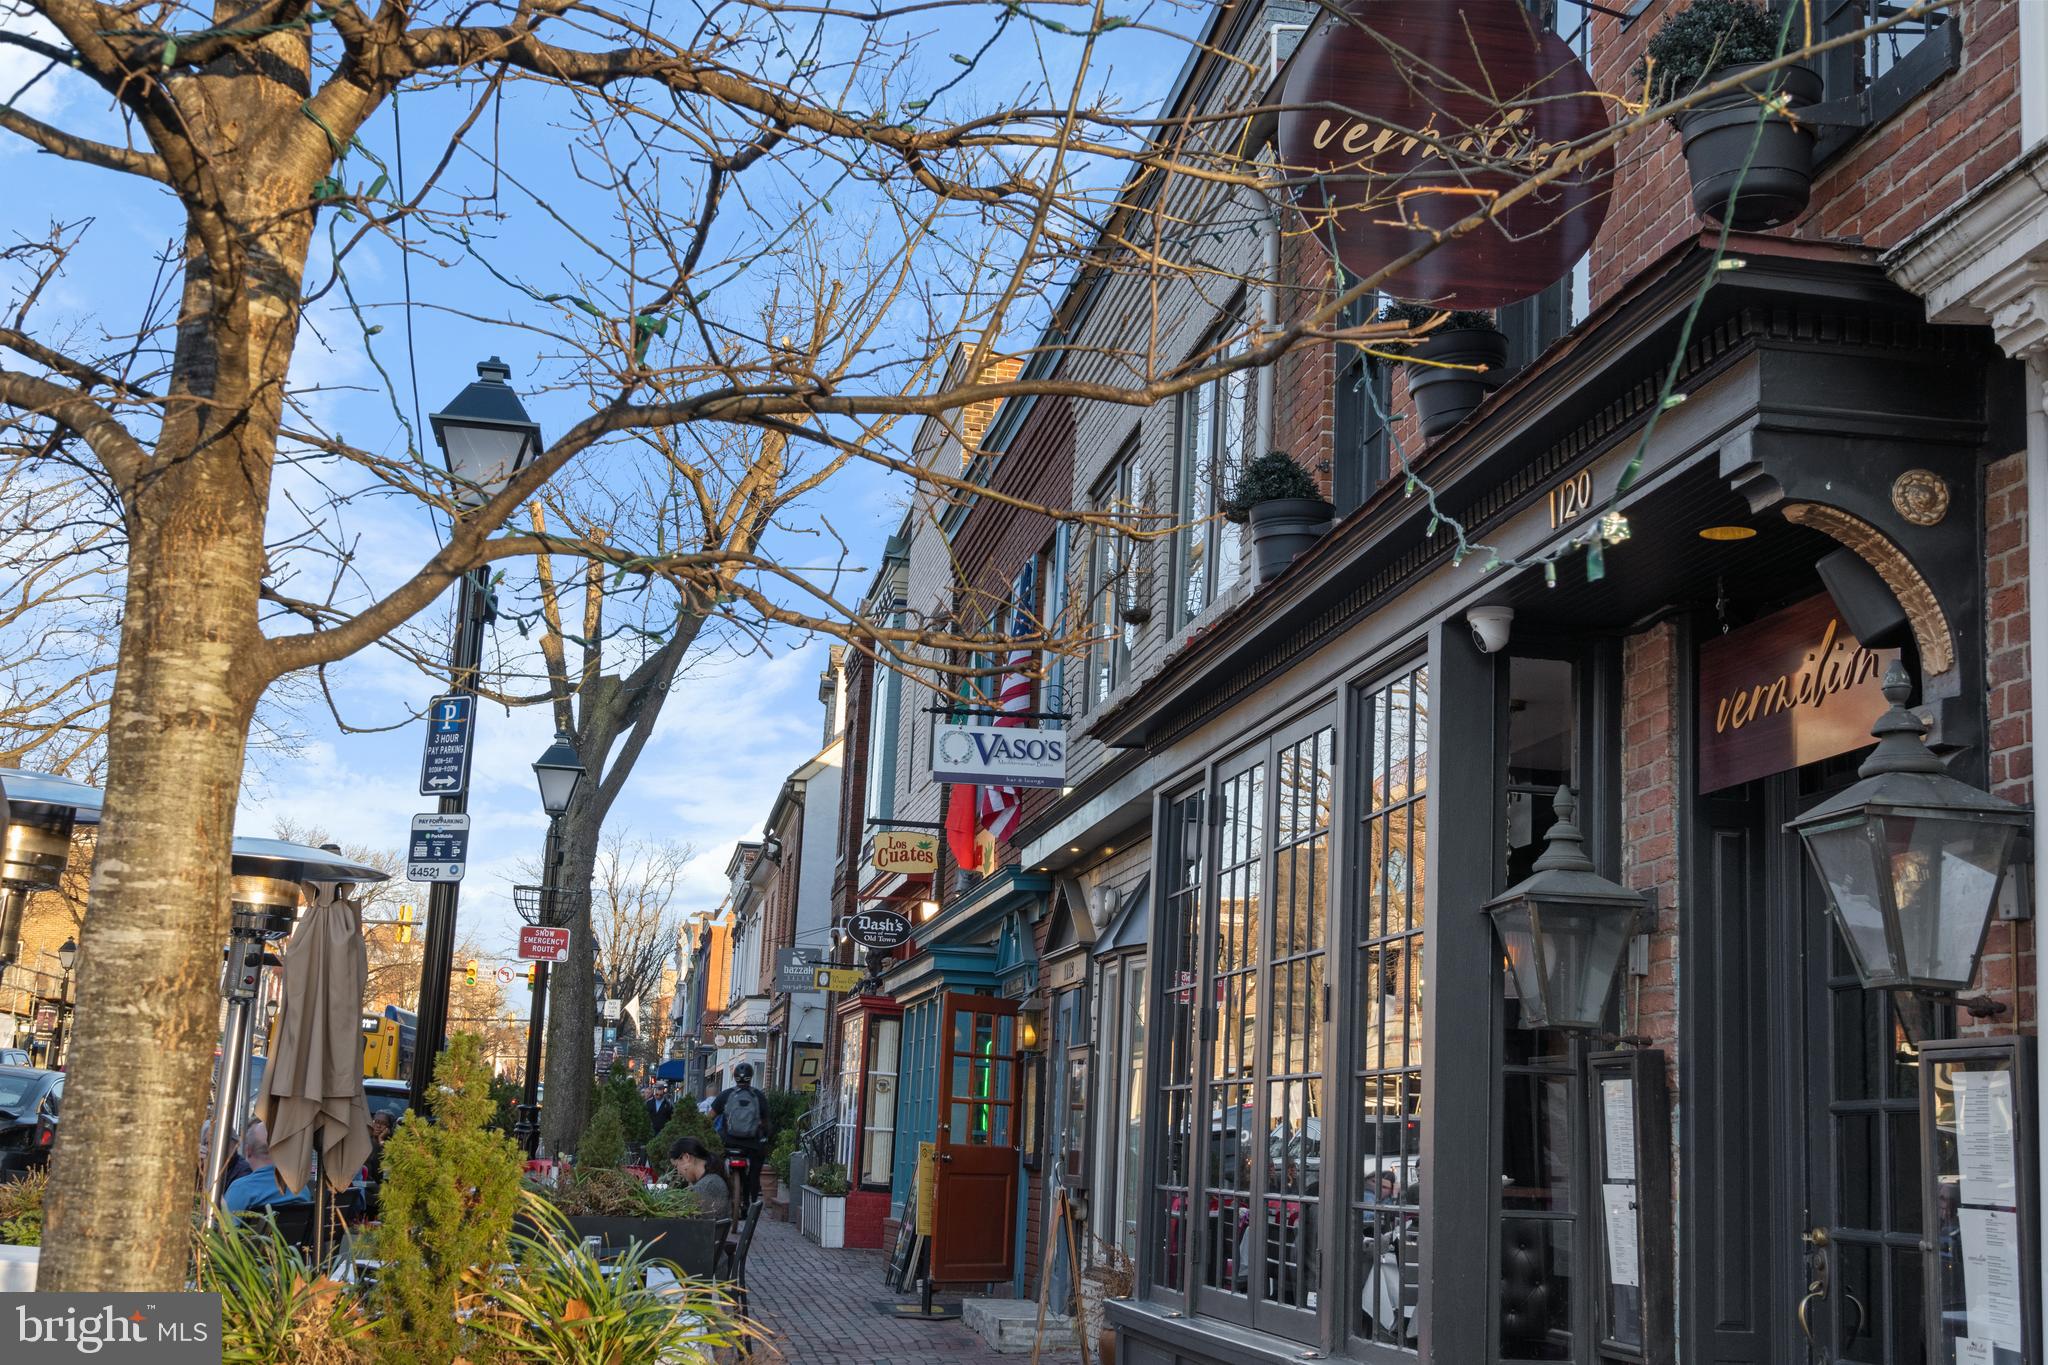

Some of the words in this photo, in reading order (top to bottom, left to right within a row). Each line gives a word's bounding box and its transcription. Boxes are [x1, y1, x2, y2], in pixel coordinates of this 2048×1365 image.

[1549, 469, 1591, 529] 1120
[442, 704, 457, 730] P
[434, 734, 440, 743] 3
[440, 733, 460, 743] HOUR
[427, 746, 439, 755] PAY
[440, 745, 464, 755] PARKING
[969, 732, 1062, 766] VASO'S
[888, 836, 907, 849] Los
[877, 846, 934, 867] Cuates
[410, 867, 440, 877] 44521
[858, 916, 904, 932] Dash's
[523, 936, 565, 945] EMERGENCY
[863, 934, 876, 942] Old
[877, 935, 897, 943] Town
[532, 945, 555, 953] ROUTE
[727, 1034, 758, 1044] AUGIE'S
